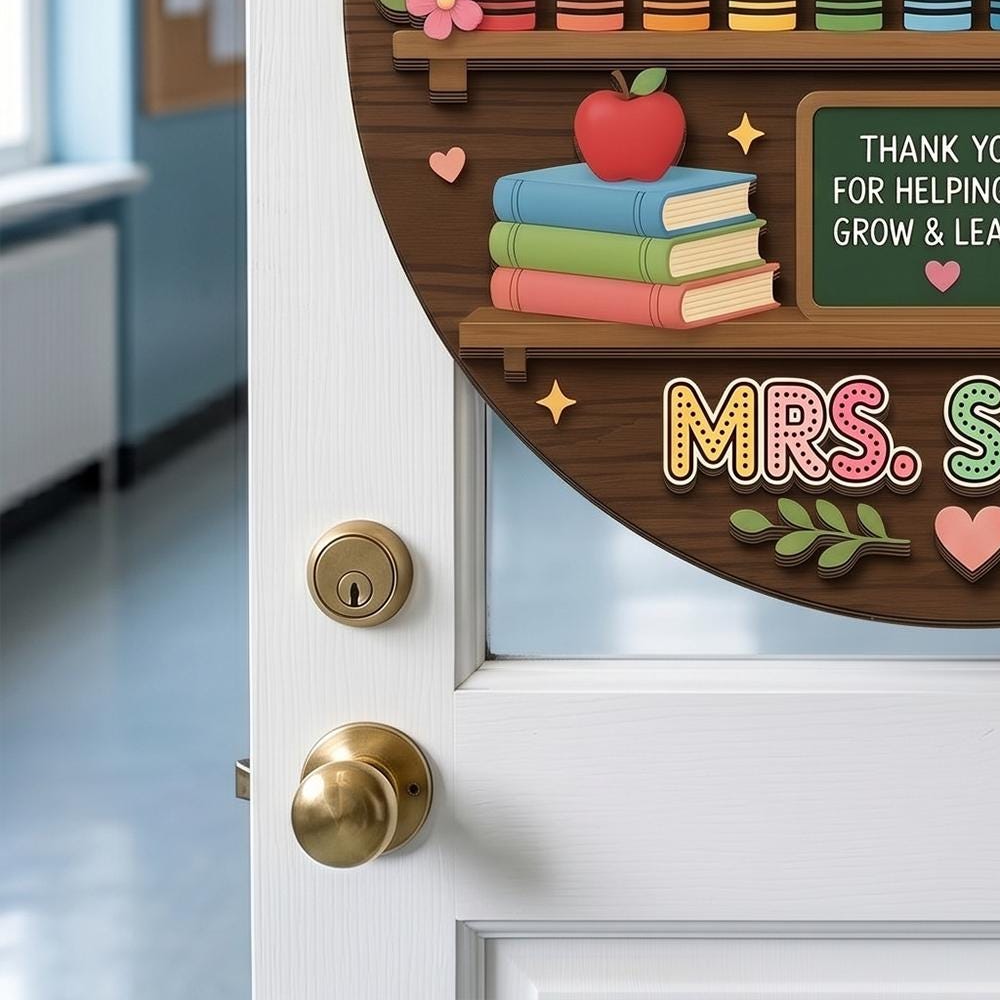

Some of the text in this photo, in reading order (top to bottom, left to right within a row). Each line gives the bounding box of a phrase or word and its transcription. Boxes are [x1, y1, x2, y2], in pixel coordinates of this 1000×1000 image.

[860, 134, 959, 163] THANK
[833, 176, 884, 204] FOR
[833, 217, 914, 246] GROW
[924, 217, 944, 246] &
[663, 375, 922, 487] MRS.
